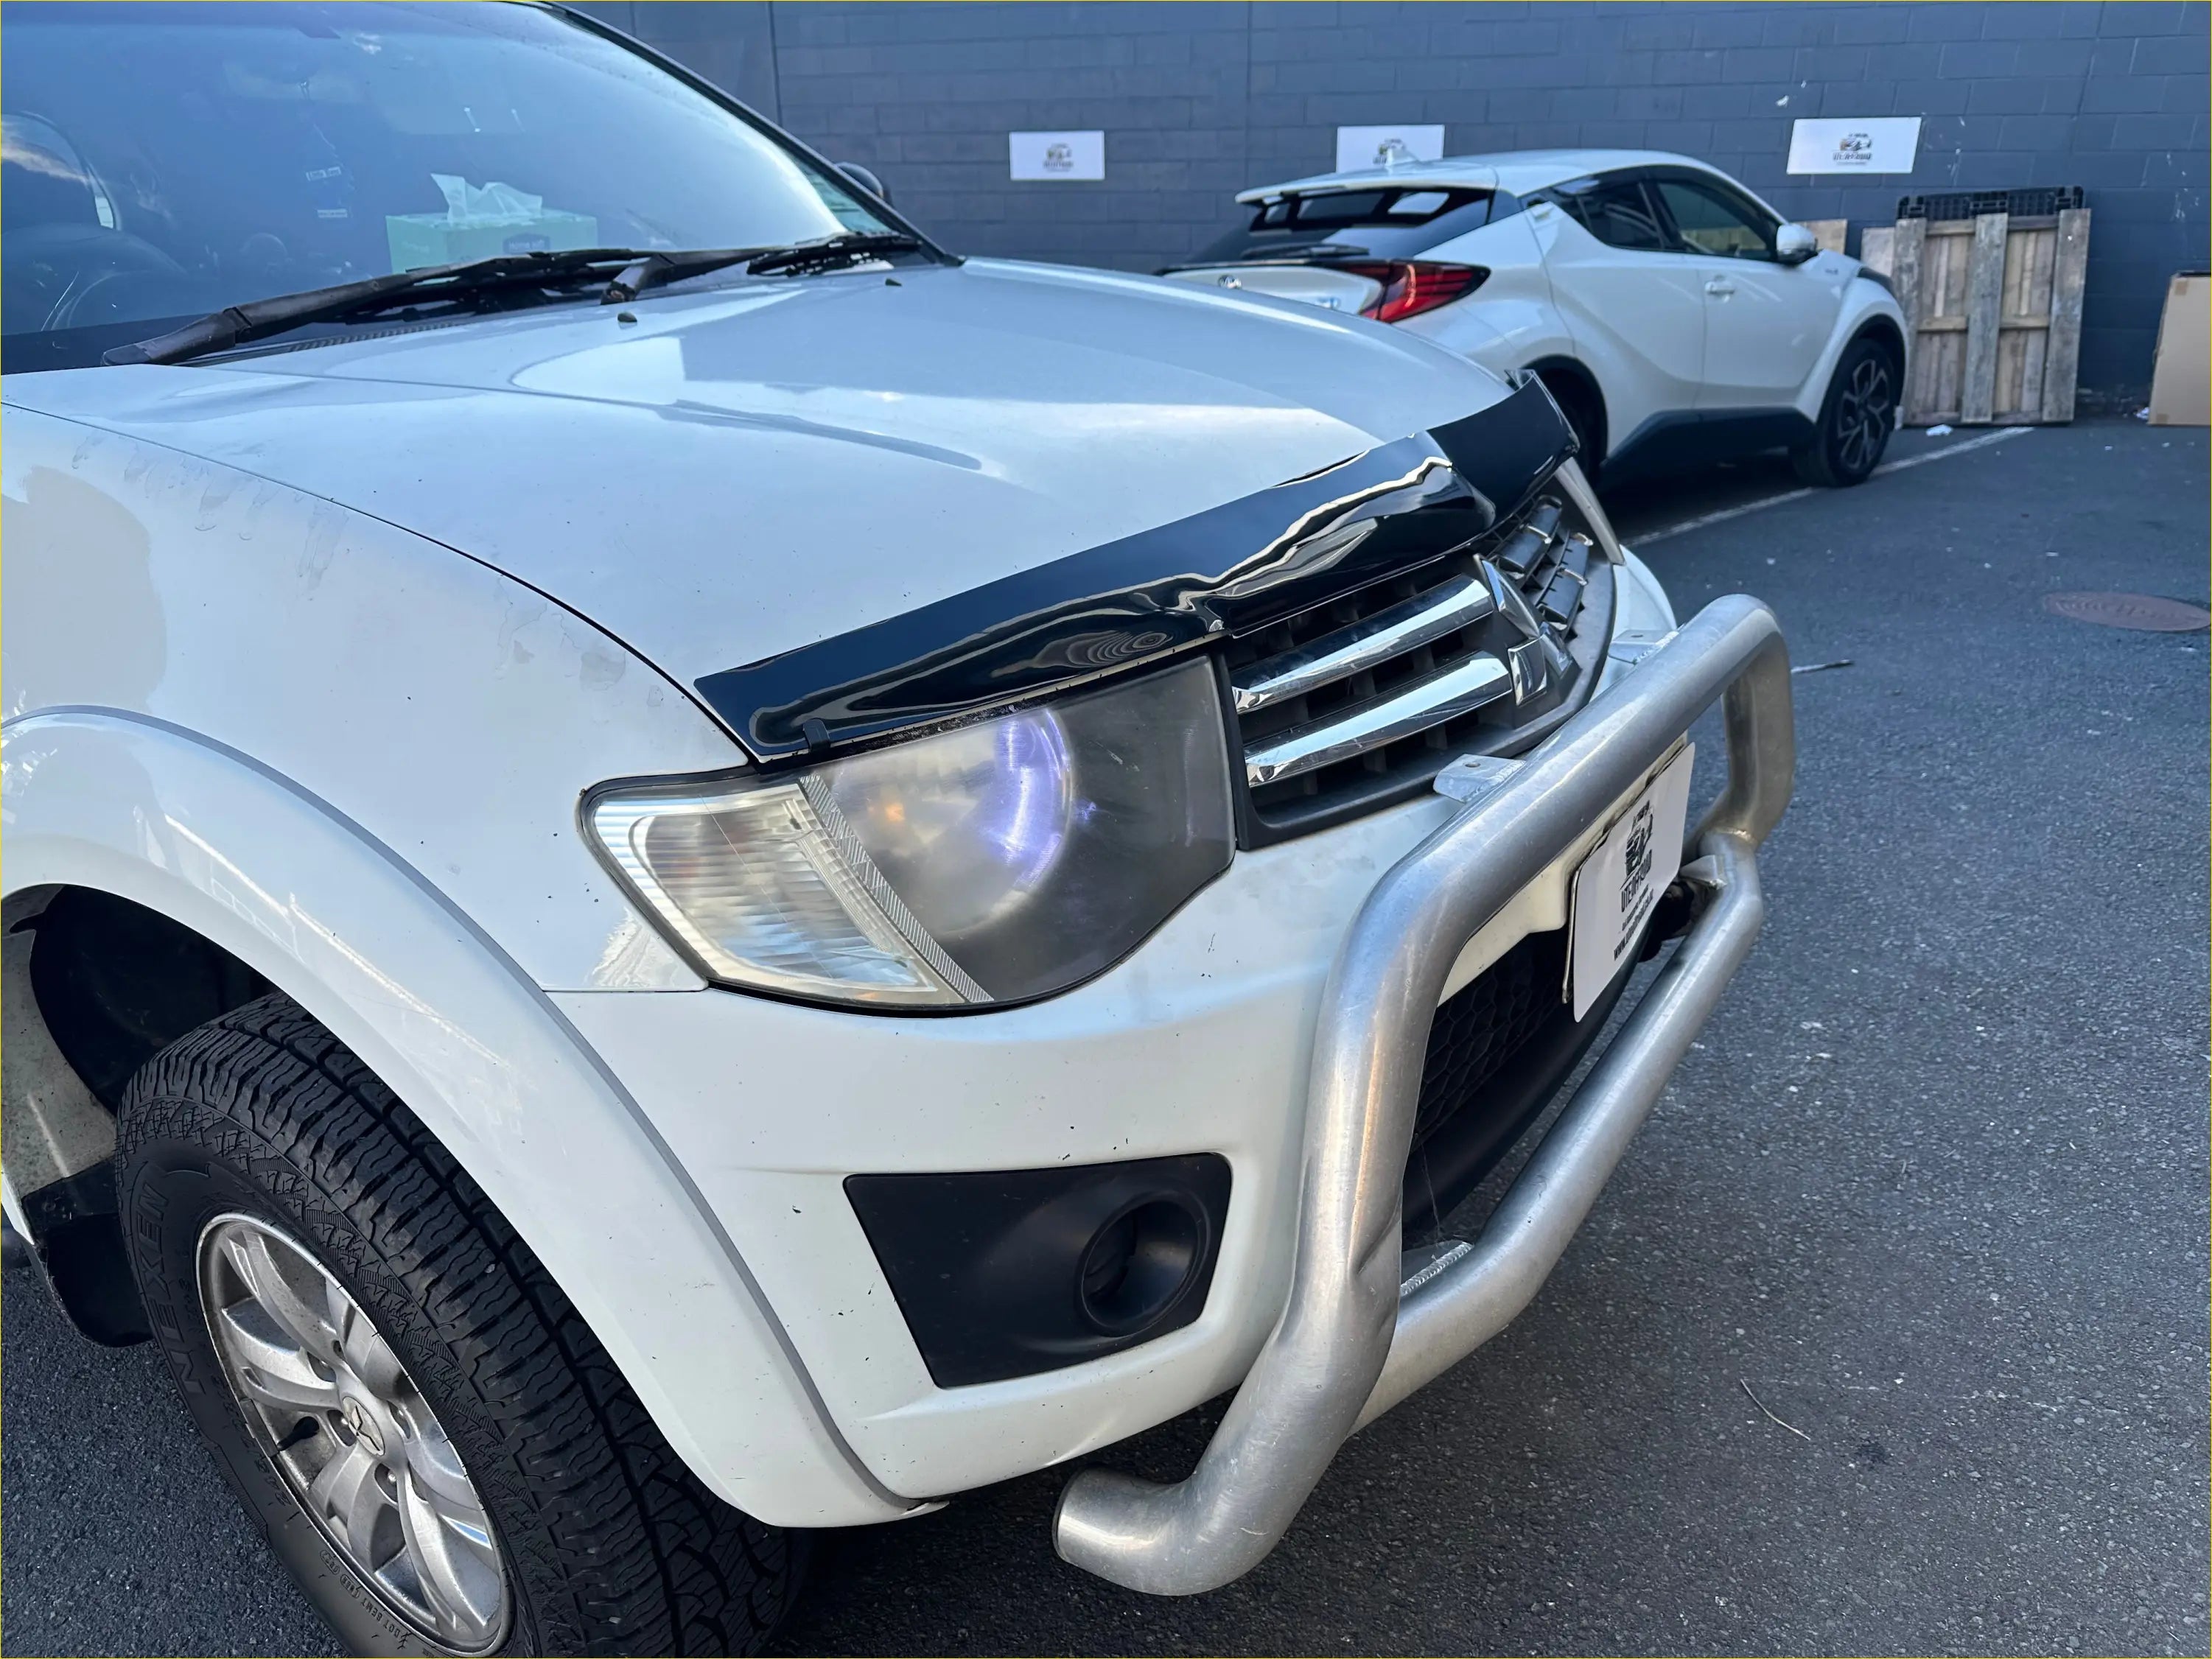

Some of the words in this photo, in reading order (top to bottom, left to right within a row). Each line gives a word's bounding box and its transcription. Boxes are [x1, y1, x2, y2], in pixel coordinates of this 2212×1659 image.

[1621, 849, 1652, 913] UTEOFFROAD
[137, 1182, 206, 1394] NEXEN
[382, 1619, 399, 1638] DOT
